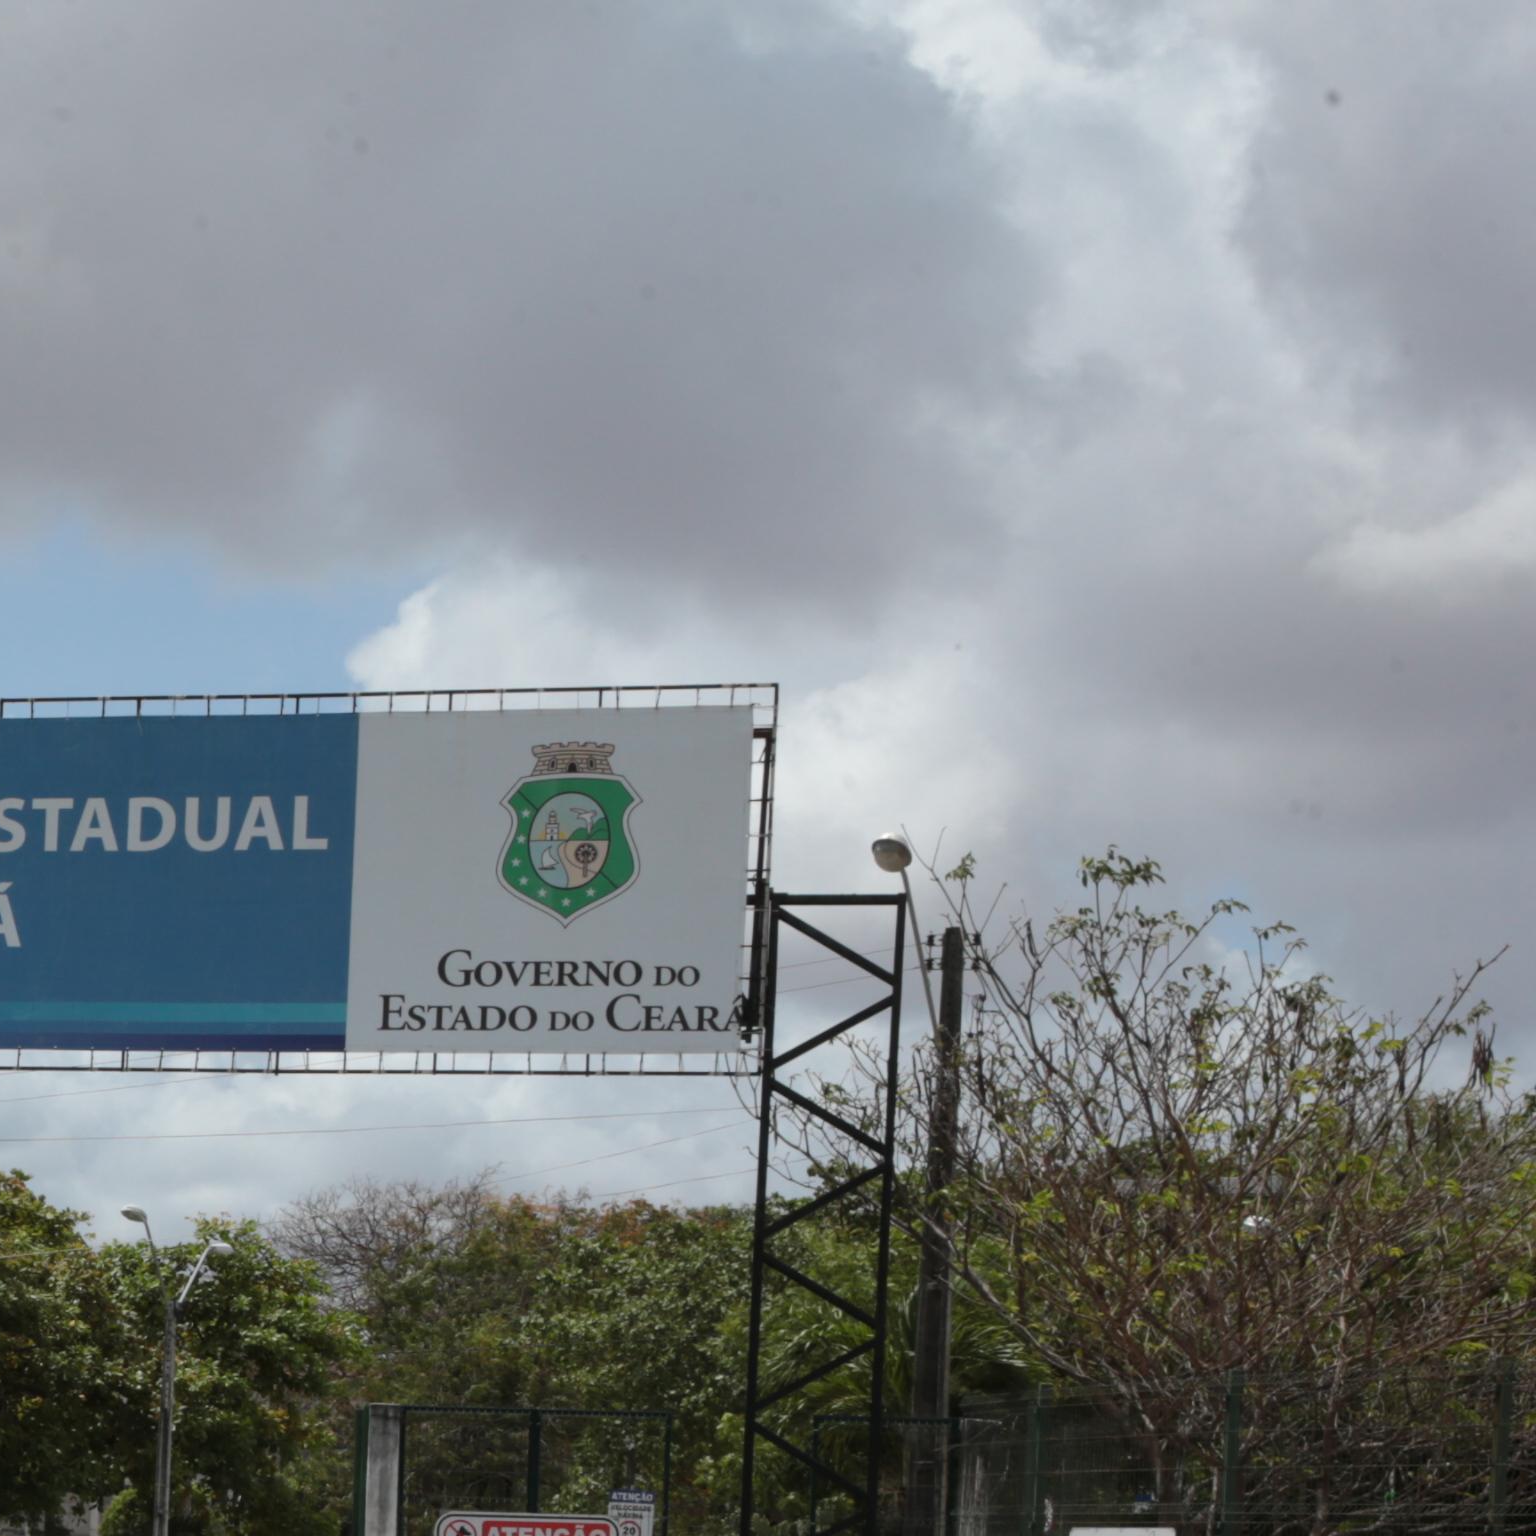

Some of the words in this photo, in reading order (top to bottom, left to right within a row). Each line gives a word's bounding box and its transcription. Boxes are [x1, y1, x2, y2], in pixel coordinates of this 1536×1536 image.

[437, 949, 642, 987] GOVERNO
[653, 965, 701, 987] DO
[379, 994, 537, 1032] ESTADO
[548, 1011, 593, 1033] DO
[612, 1492, 653, 1502] ATENÇÃO
[623, 1526, 636, 1535] 20
